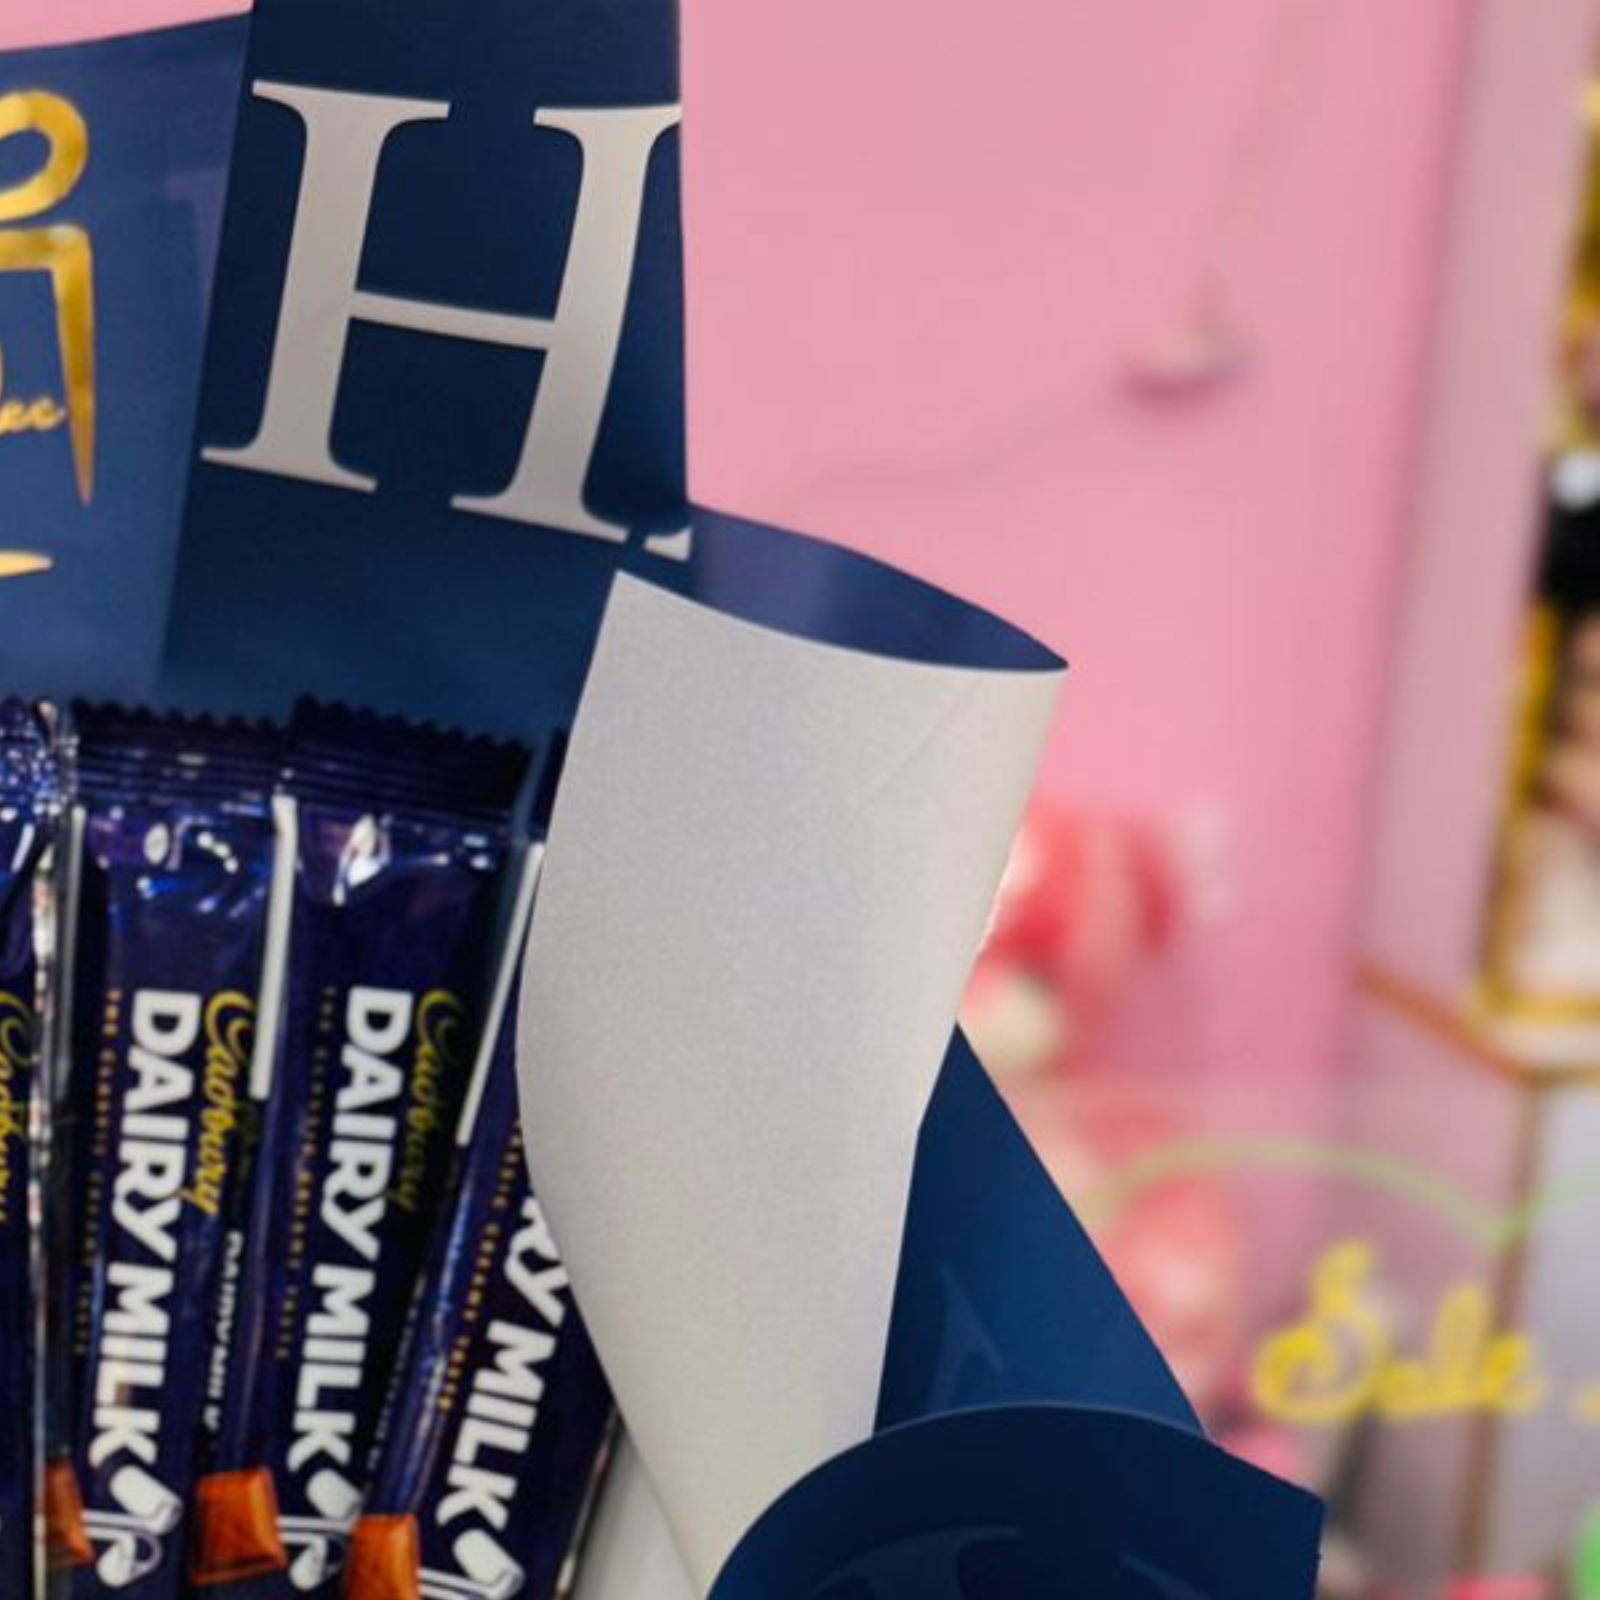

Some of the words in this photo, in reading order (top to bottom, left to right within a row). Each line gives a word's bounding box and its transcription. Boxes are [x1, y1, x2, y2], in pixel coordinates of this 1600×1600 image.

[110, 989, 203, 1262] DAIRY
[320, 986, 414, 1262] DAIRY
[87, 1261, 176, 1470] MILK
[287, 1263, 377, 1473] MILK
[435, 1319, 558, 1531] MILK
